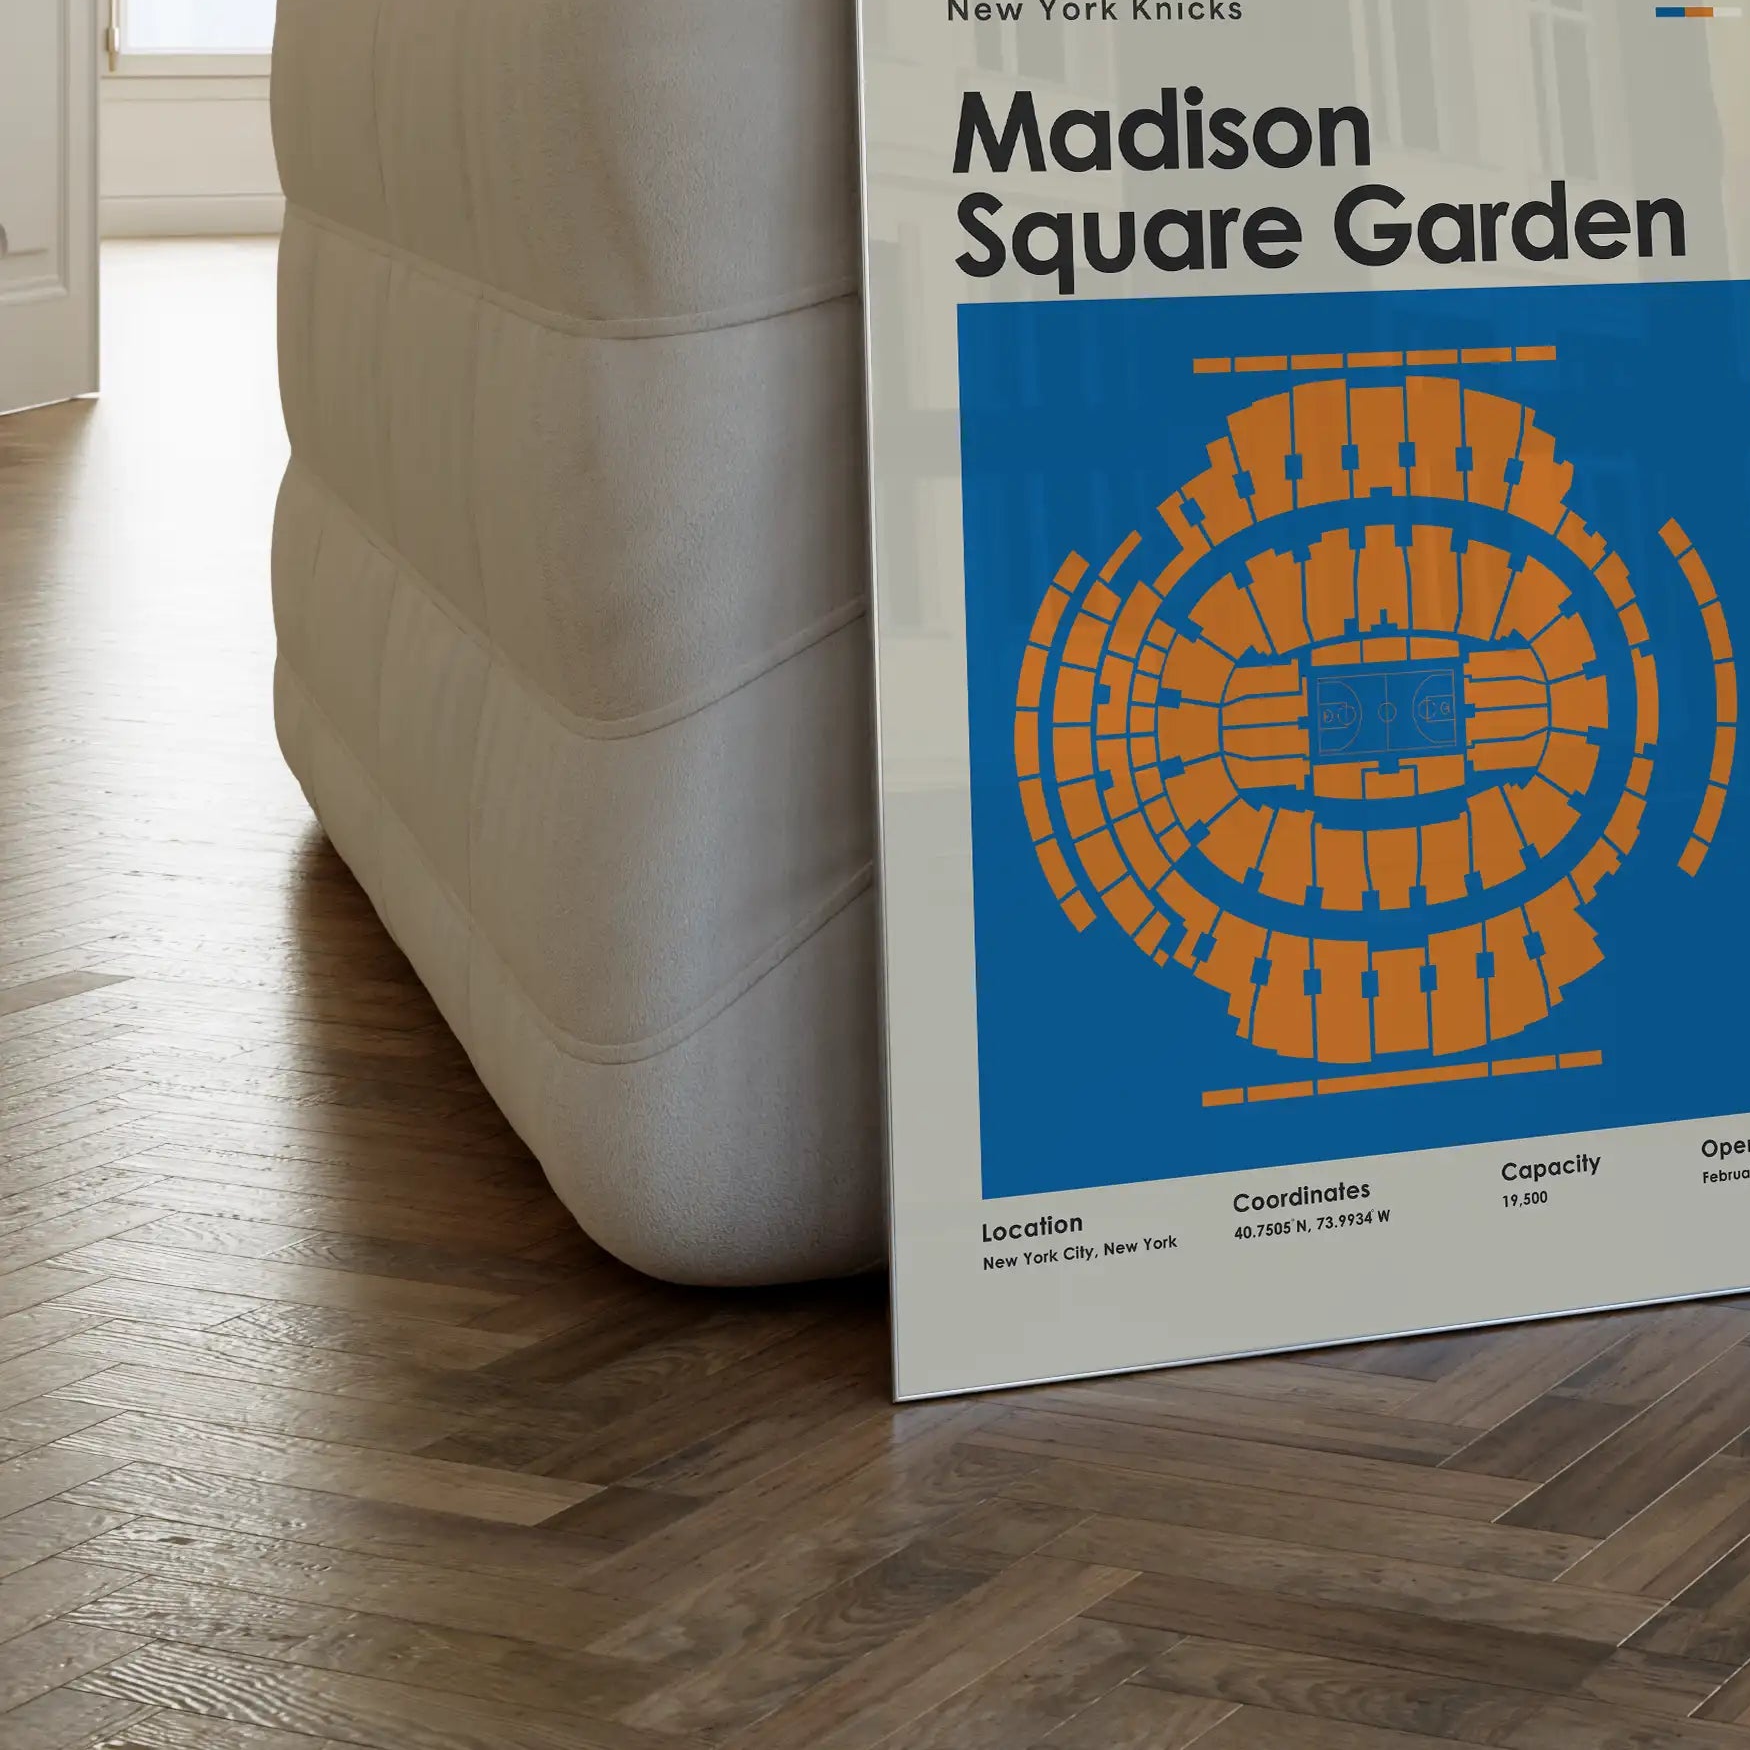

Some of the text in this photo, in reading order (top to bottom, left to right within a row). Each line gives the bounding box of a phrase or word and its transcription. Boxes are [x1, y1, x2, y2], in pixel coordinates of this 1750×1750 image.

[952, 85, 1371, 174] Madison
[954, 179, 1686, 296] Square Garden
[1501, 1153, 1602, 1183] Capacity
[1233, 1181, 1371, 1213] Coordinates
[1502, 1190, 1548, 1208] 19,500
[982, 1215, 1083, 1243] Location
[983, 1234, 1178, 1271] New York City, New York
